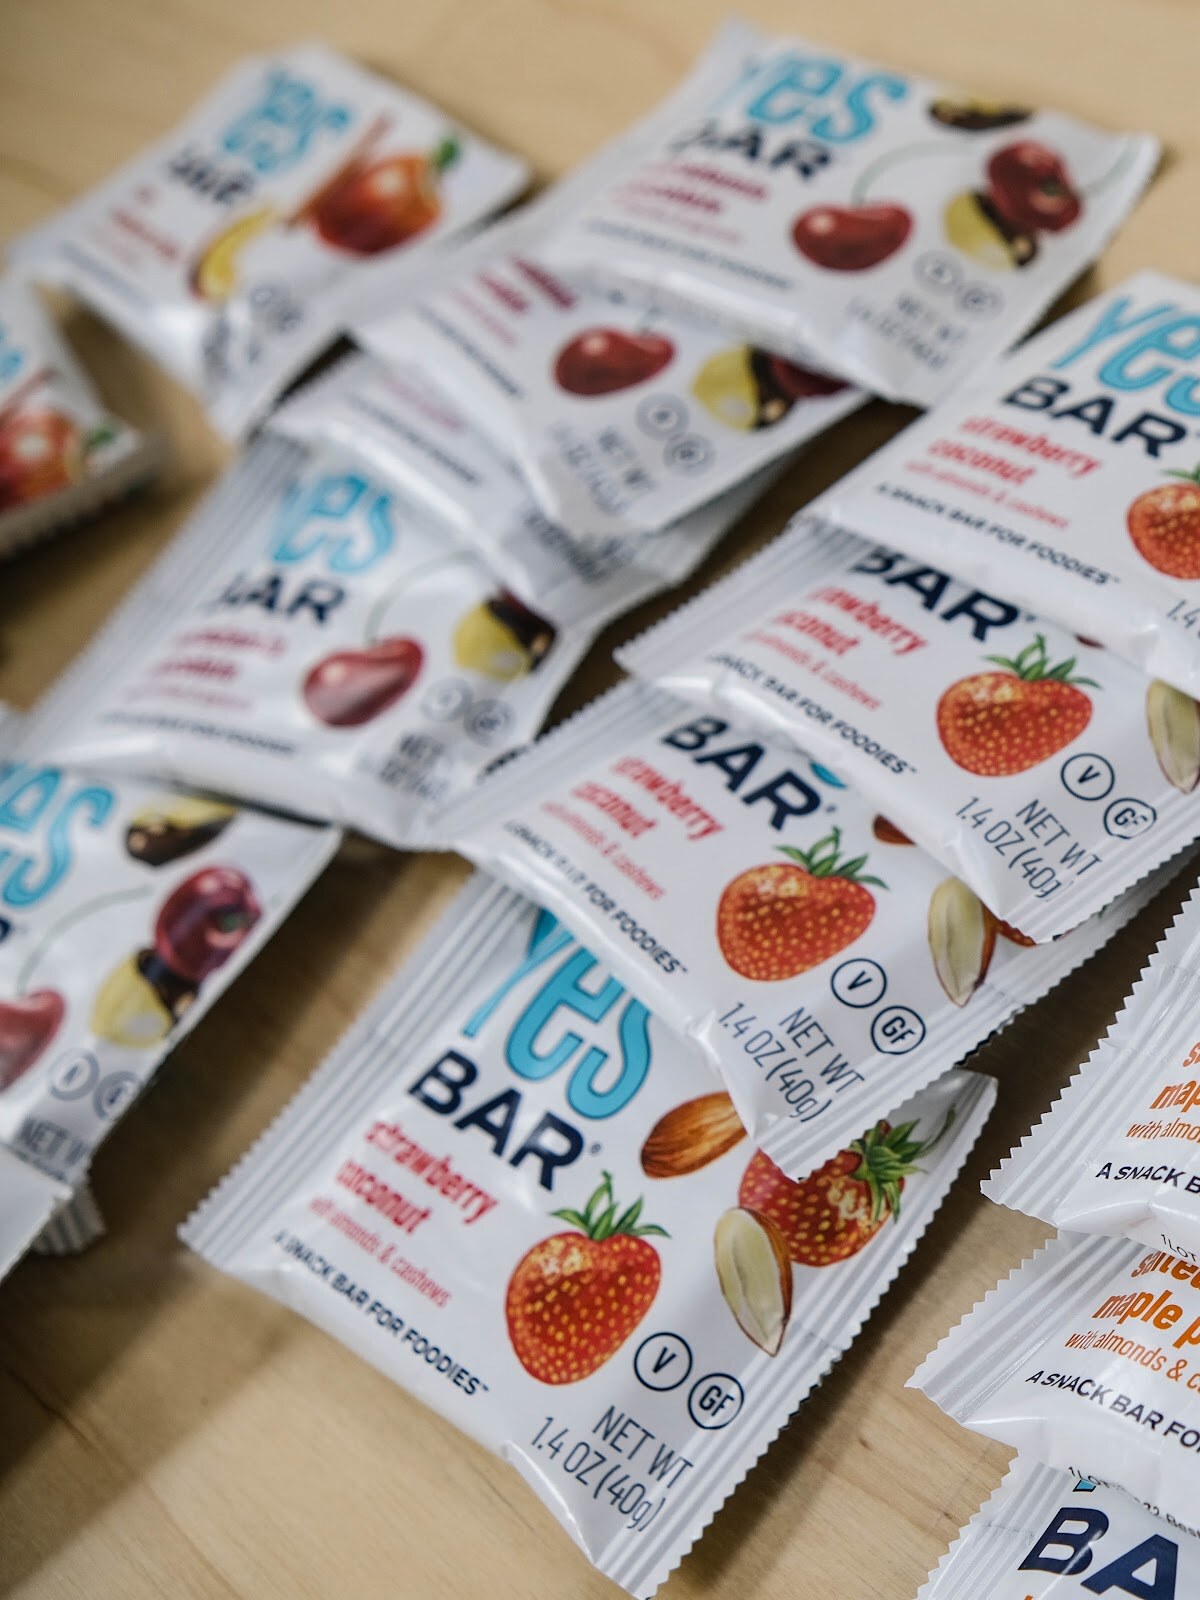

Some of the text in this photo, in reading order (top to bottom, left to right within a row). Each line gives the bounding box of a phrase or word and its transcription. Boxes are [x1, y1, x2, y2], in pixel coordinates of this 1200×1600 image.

[1002, 376, 1187, 459] BAR
[659, 714, 822, 833] BAR
[956, 796, 993, 829] 1.4
[983, 820, 1025, 857] OZ
[1015, 799, 1071, 847] NET
[718, 1001, 833, 1123] 1.4 OZ (40g)
[778, 1006, 866, 1093] NET WT
[1125, 1119, 1162, 1140] with
[1095, 1162, 1113, 1181] A
[1113, 1164, 1187, 1188] SNACK
[368, 1300, 405, 1337] FOR
[1092, 1289, 1183, 1330] maple
[1064, 1330, 1095, 1351] with
[1094, 1329, 1168, 1372] almonds
[1166, 1358, 1188, 1383] &
[698, 1384, 736, 1418] GF
[1025, 1369, 1045, 1384] A
[1040, 1373, 1112, 1406] SNACK
[1109, 1393, 1165, 1431] BAR
[531, 1416, 667, 1532] 1.4 OZ (40g)
[592, 1405, 694, 1489] NET WT
